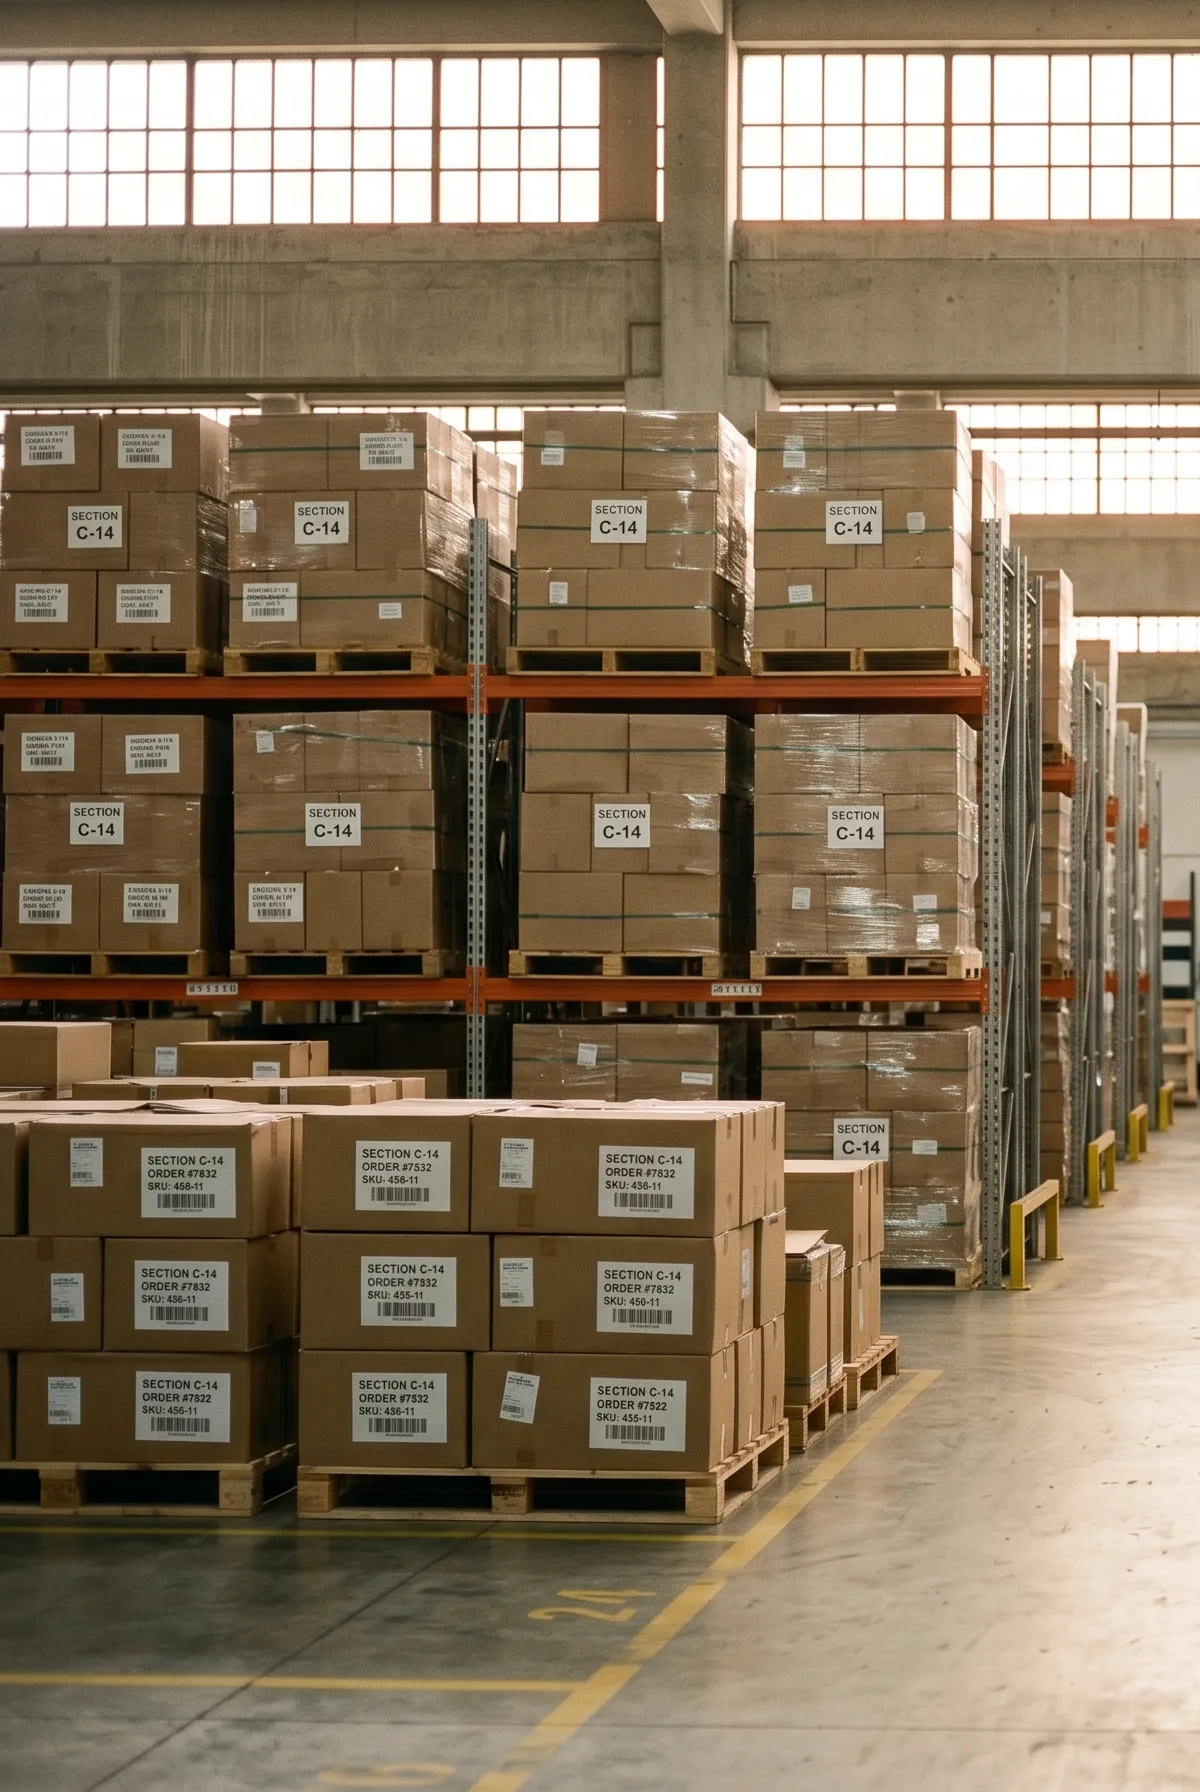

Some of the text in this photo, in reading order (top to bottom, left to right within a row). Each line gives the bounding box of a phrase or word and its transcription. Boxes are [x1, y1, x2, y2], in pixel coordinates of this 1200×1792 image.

[298, 507, 344, 516] SECTION
[596, 506, 642, 514] SECTION
[830, 506, 876, 515] SECTION
[72, 512, 117, 521] SECTION
[303, 522, 340, 535] C-14
[600, 521, 637, 534] C-14
[834, 521, 872, 535] C-14
[77, 526, 114, 539] C-14
[74, 808, 120, 816] SECTION
[310, 809, 356, 817] SECTION
[599, 810, 645, 818] SECTION
[832, 811, 879, 820] SECTION
[78, 823, 115, 836] C-14
[314, 824, 352, 837] C-14
[603, 826, 641, 838] C-14
[837, 827, 874, 840] C-14
[838, 1125, 884, 1133] SECTION
[843, 1140, 880, 1154] C-14
[363, 1149, 438, 1159] SECTION C-14
[148, 1156, 223, 1165] SECTION C-14
[606, 1154, 682, 1165] SECTION C-14
[362, 1163, 431, 1171] ORDER #7532
[148, 1169, 184, 1178] ORDER
[606, 1168, 642, 1177] ORDER
[605, 1180, 629, 1189] SKU:
[142, 1269, 216, 1278] SECTION C-14
[368, 1264, 444, 1274] SECTION C-14
[604, 1270, 681, 1280] SECTION C-14
[142, 1282, 178, 1290] ORDER
[368, 1278, 404, 1286] ORDER
[604, 1284, 641, 1293] ORDER
[142, 1295, 164, 1303] SKU:
[604, 1297, 626, 1305] SKU:
[143, 1380, 218, 1390] SECTION C-14
[359, 1380, 434, 1390] SECTION C-14
[598, 1386, 673, 1397] SECTION C-14
[143, 1393, 179, 1402] ORDER
[359, 1394, 428, 1403] ORDER #7532
[597, 1400, 634, 1409] ORDER
[142, 1406, 196, 1415] SKU: 456-11
[359, 1407, 381, 1415] SKU:
[597, 1413, 619, 1421] SKU:
[527, 1588, 657, 1622] 24
